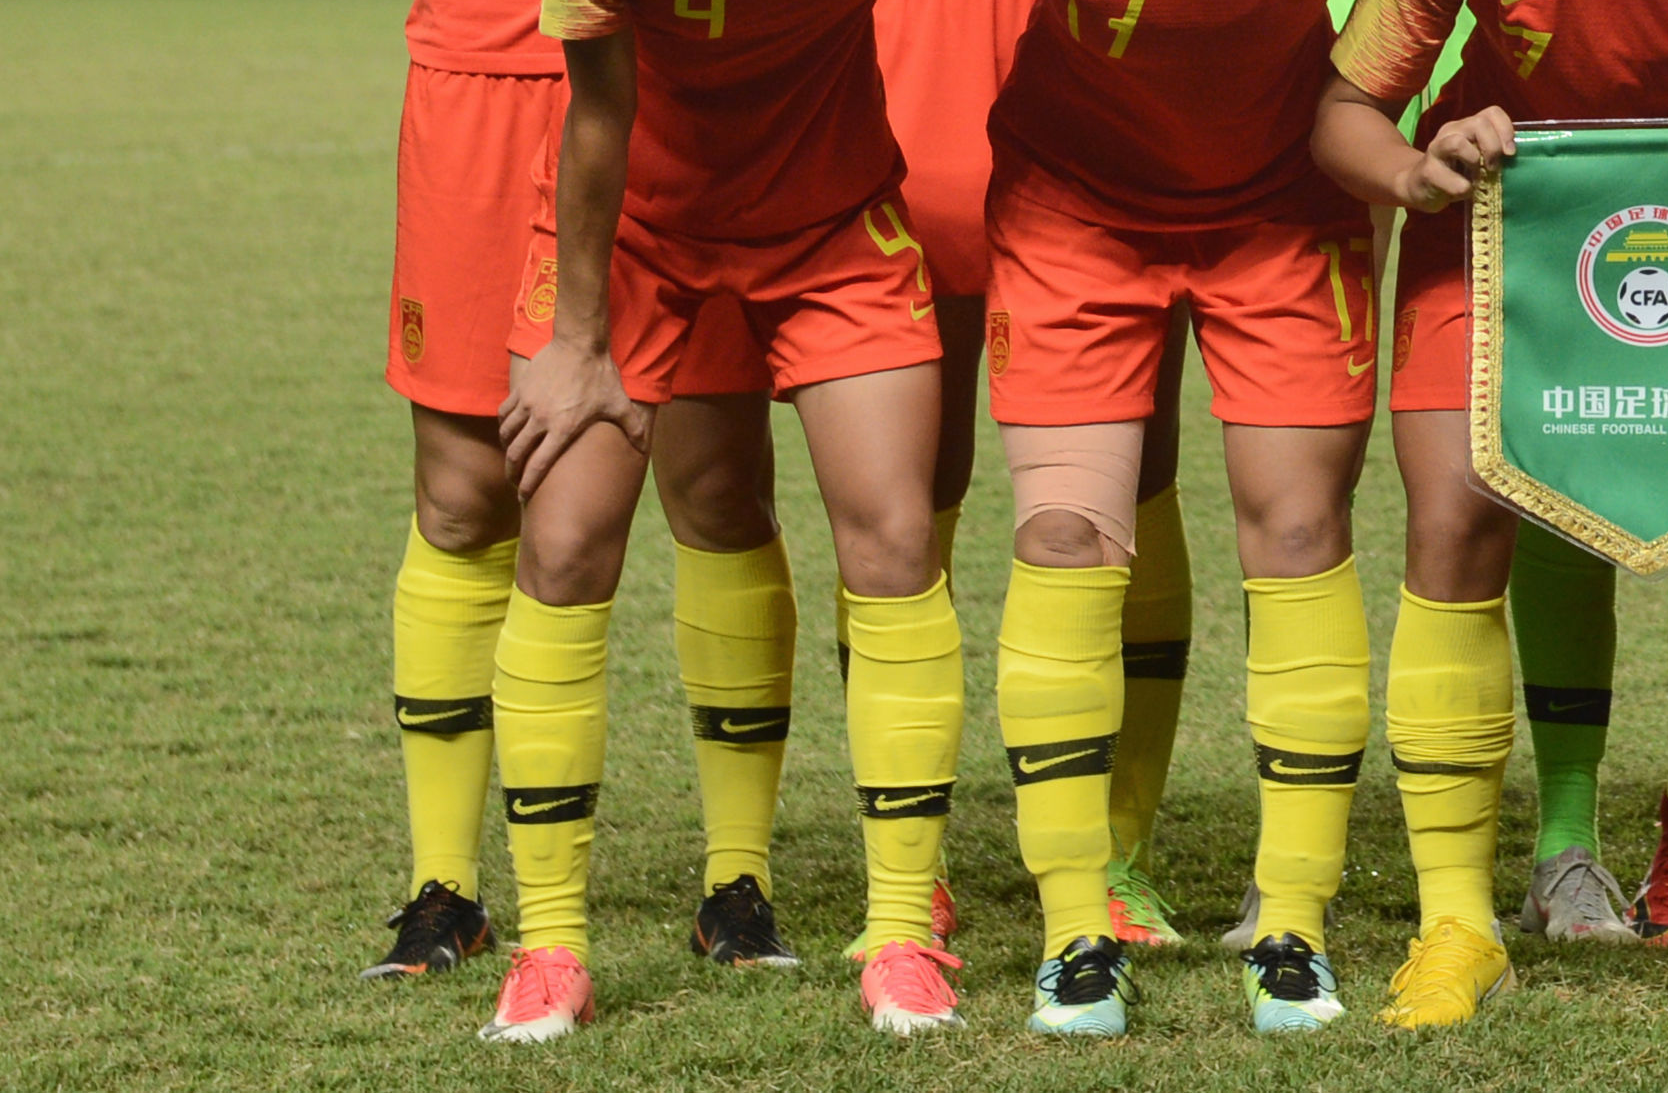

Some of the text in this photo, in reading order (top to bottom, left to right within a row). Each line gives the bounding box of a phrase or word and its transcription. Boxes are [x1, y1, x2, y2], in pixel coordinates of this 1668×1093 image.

[1498, 21, 1553, 81] 7
[863, 202, 928, 293] 4
[541, 261, 558, 275] CF
[1630, 290, 1668, 306] CFA
[1542, 423, 1596, 435] CHINESE
[1602, 423, 1667, 435] FOOTBALL
